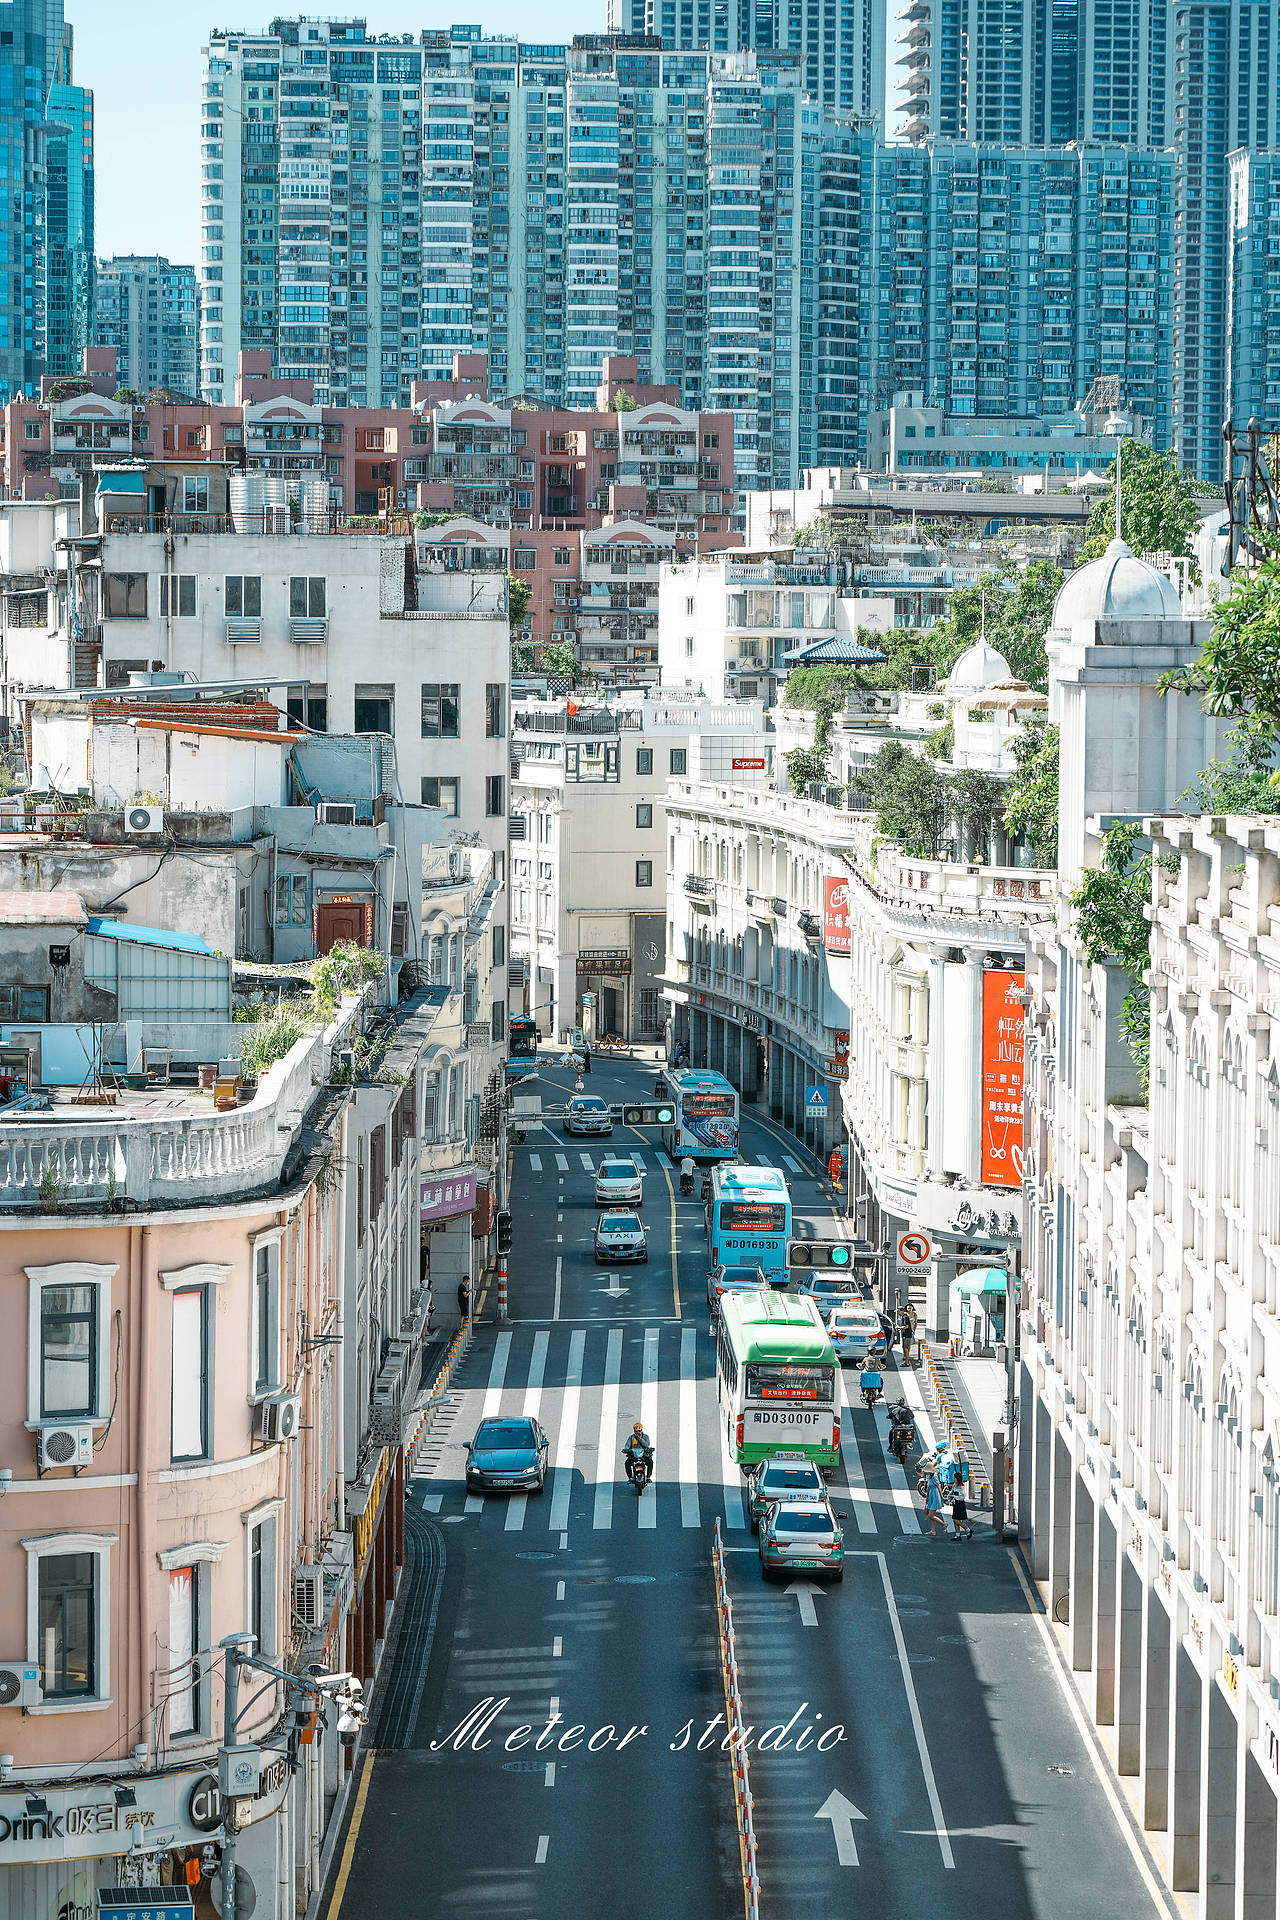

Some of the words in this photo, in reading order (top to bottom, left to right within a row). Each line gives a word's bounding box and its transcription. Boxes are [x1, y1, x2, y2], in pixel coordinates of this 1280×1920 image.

[734, 759, 763, 769] Supreme
[725, 1239, 779, 1250] 闽D01693D
[753, 1412, 820, 1425] 闽D03000F
[192, 1788, 220, 1821] CIT
[66, 1802, 120, 1835] 吸引
